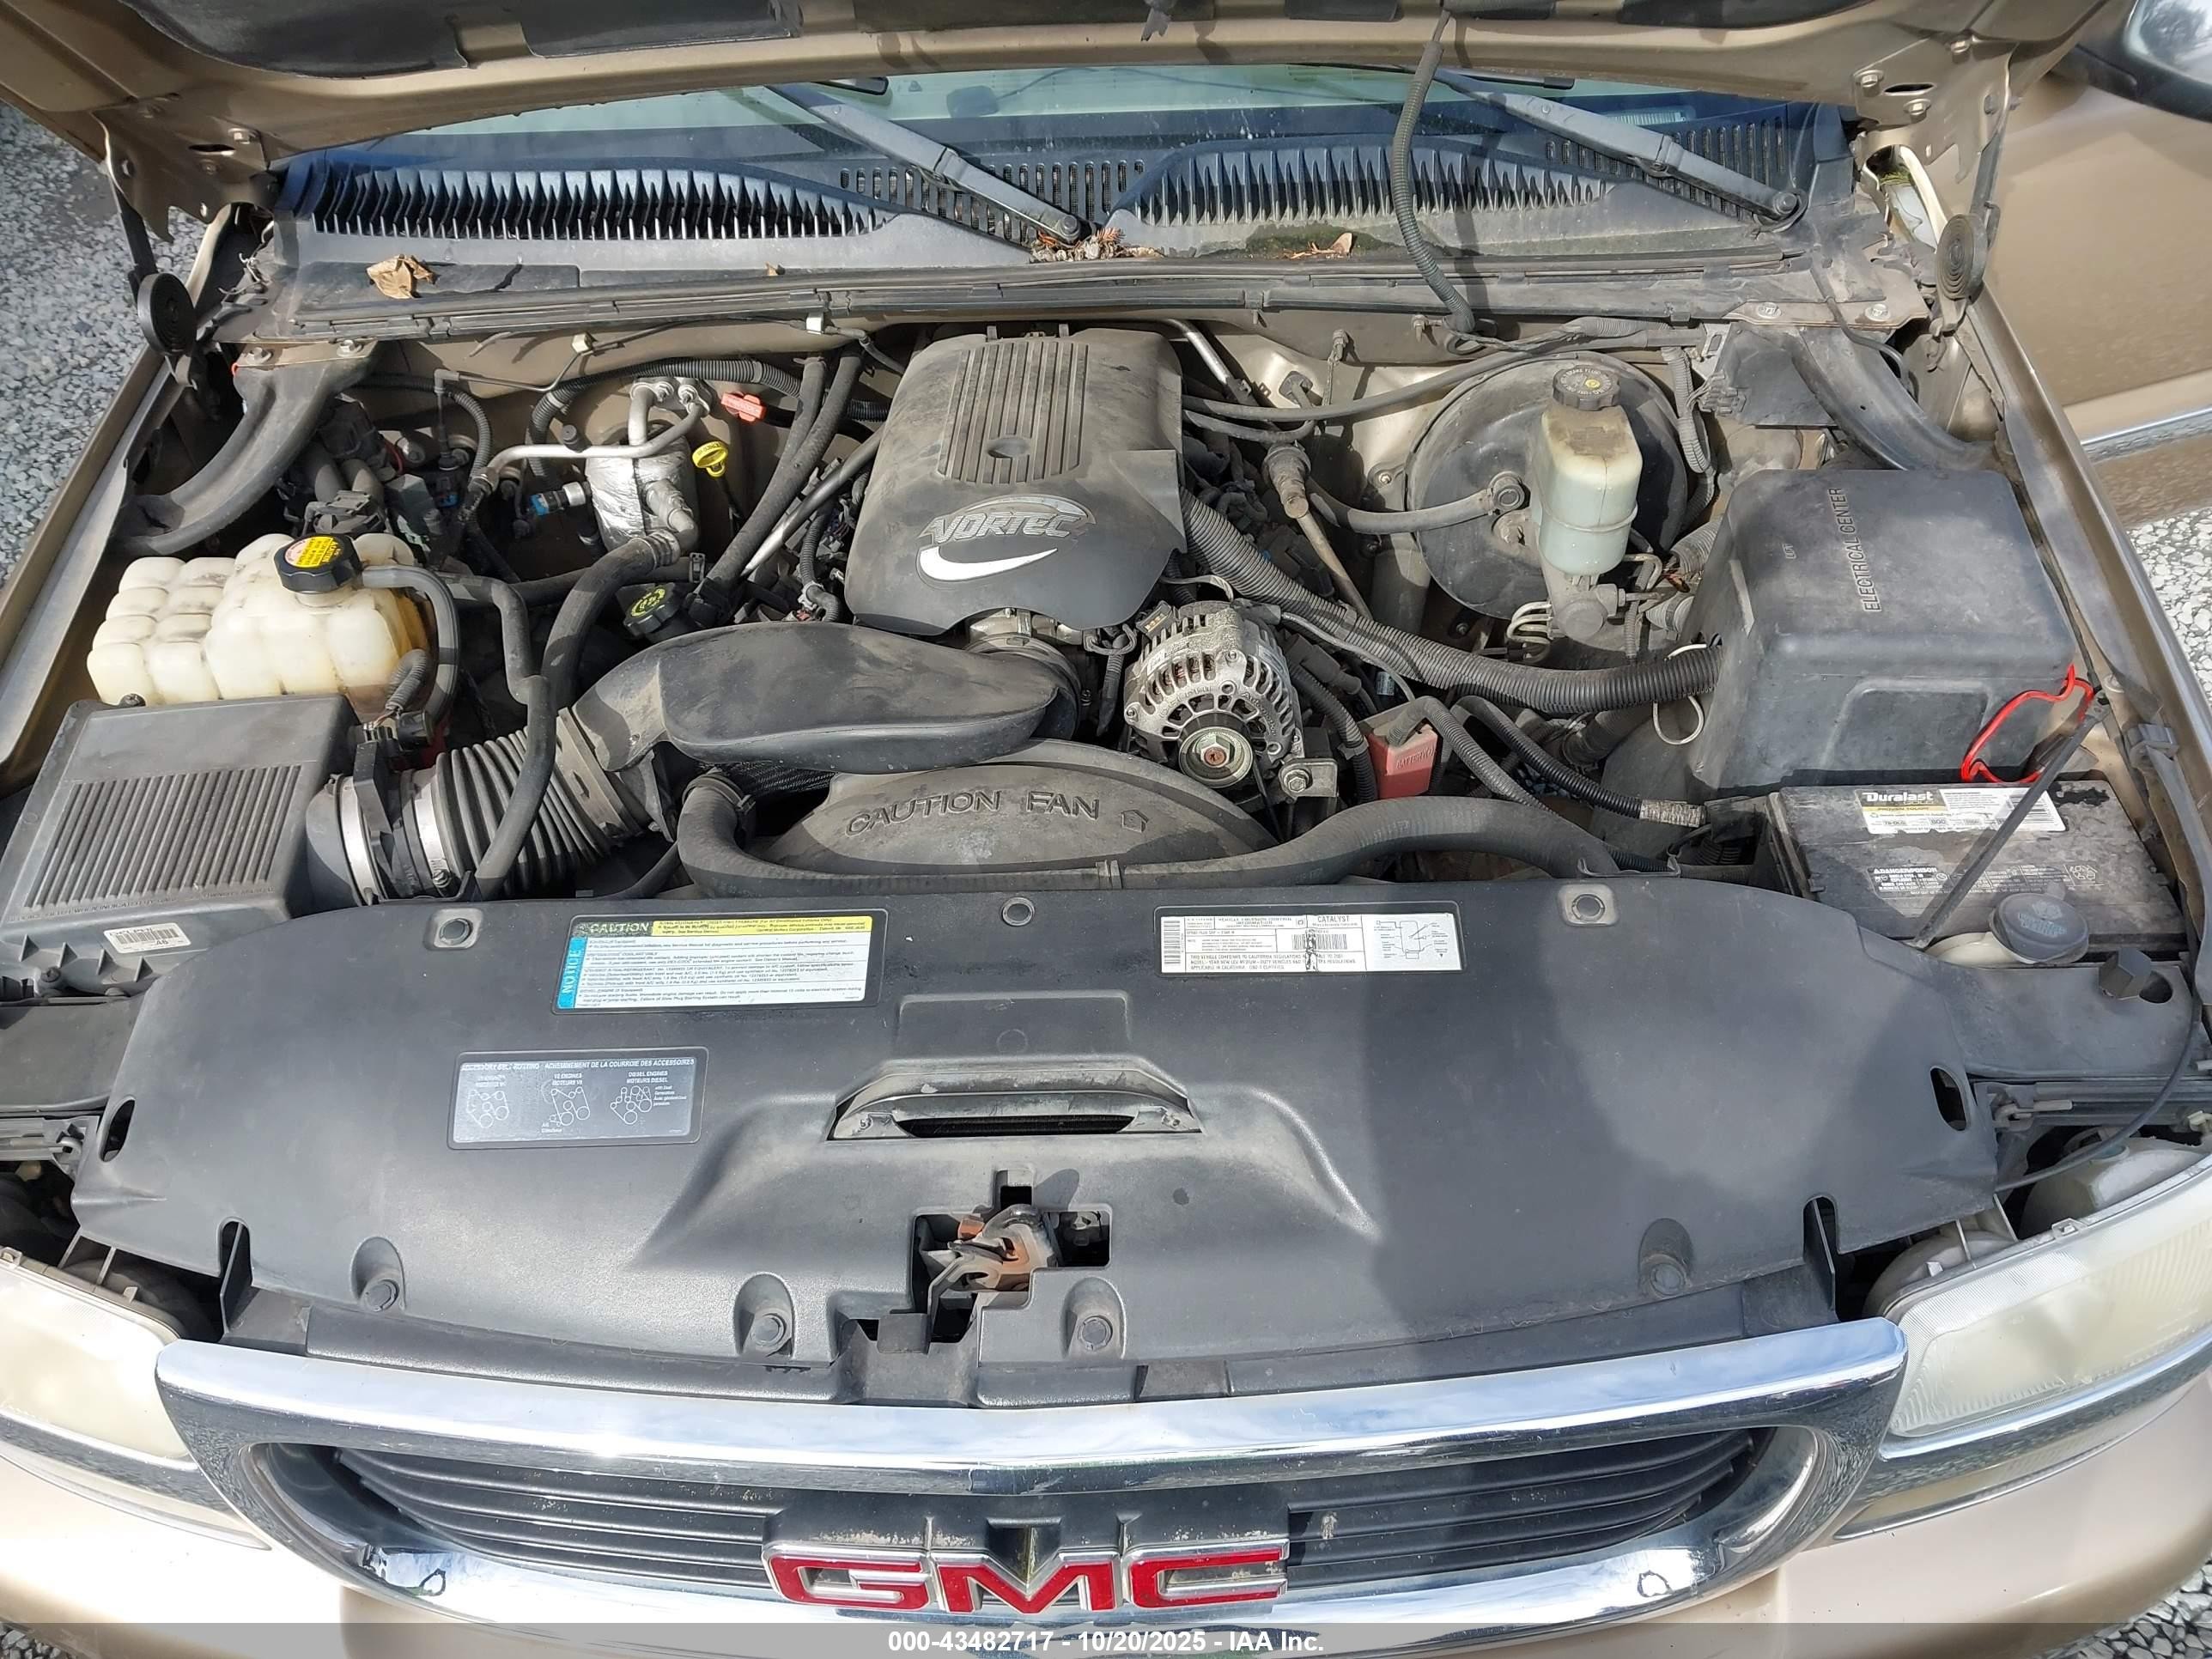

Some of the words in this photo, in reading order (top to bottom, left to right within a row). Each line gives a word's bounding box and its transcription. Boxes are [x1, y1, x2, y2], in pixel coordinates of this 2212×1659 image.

[930, 510, 1082, 545] VORTEC
[1827, 487, 1856, 535] CENTER
[1843, 536, 1883, 613] ELECTRICAL
[1862, 790, 1934, 802] Duralast
[845, 789, 1002, 839] CAUTION
[1026, 790, 1101, 821] FAN
[590, 923, 649, 933] CAUTION
[1317, 915, 1350, 923] CATALYST
[653, 1058, 695, 1066] ACCESSOIRES
[763, 1537, 1290, 1615] GMC
